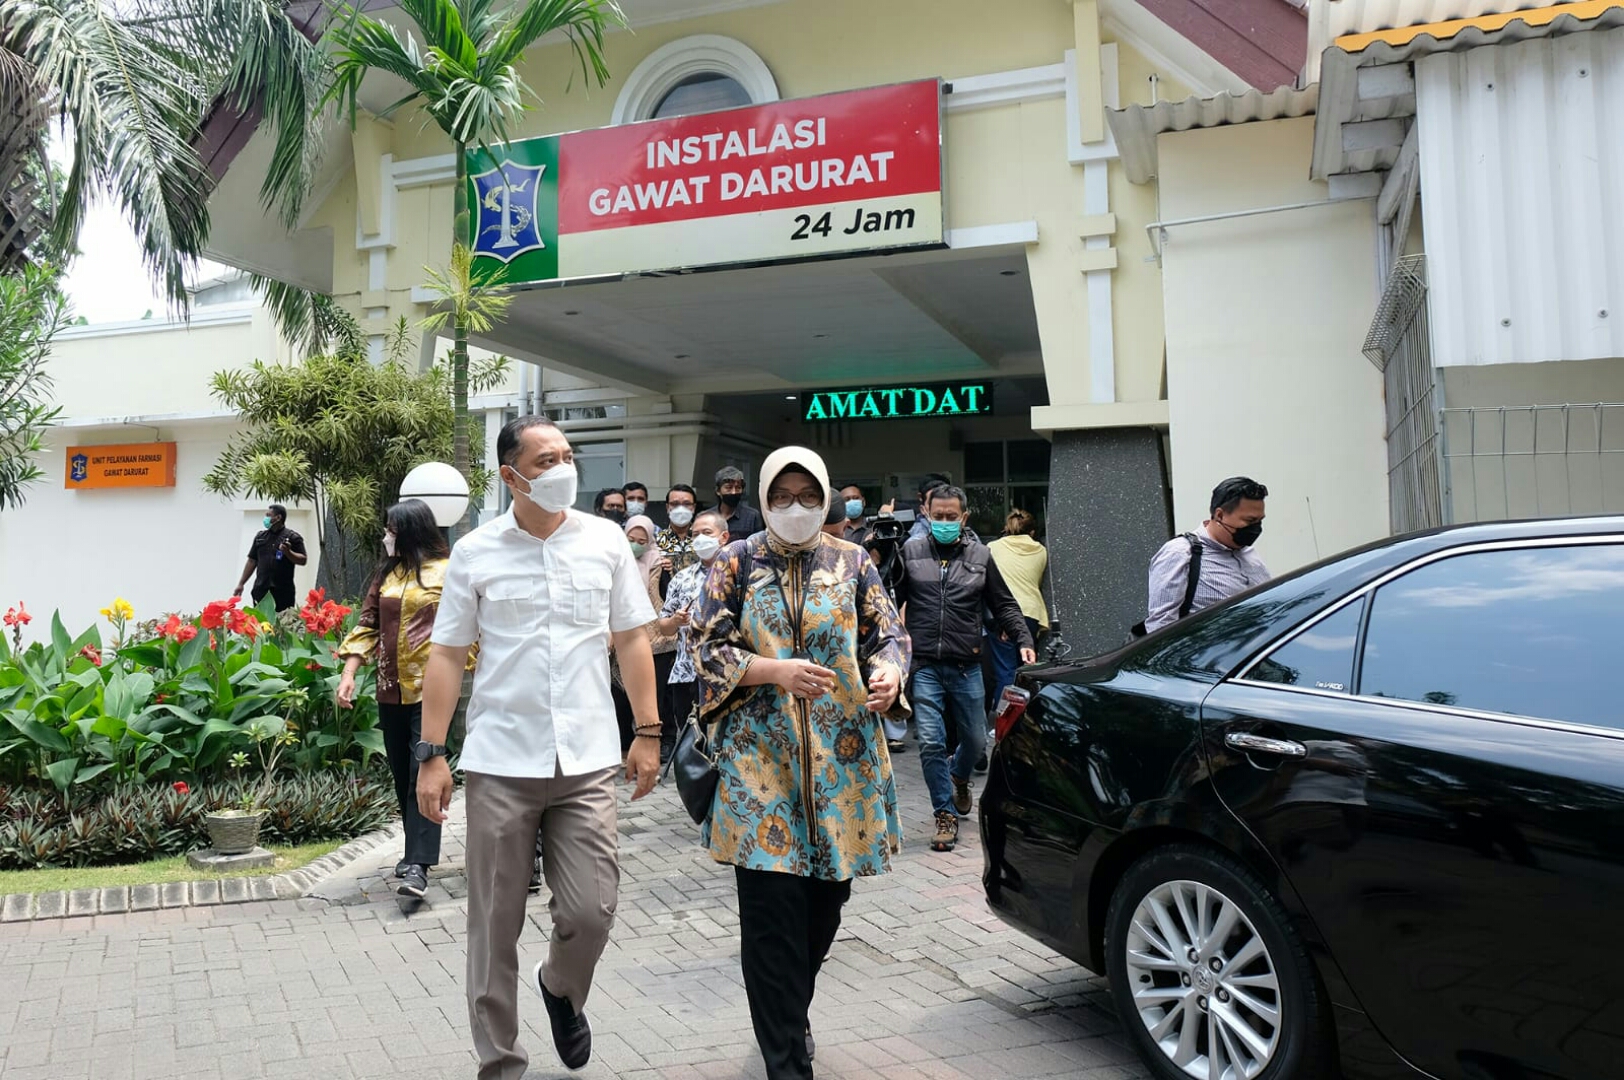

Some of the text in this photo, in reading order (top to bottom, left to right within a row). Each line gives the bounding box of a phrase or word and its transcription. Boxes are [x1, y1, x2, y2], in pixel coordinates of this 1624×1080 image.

[646, 117, 826, 169] INSTALASI
[588, 150, 894, 216] GAWAT DARURAT
[790, 208, 915, 241] 24 Jam
[806, 385, 989, 420] AMAT DAT
[92, 454, 162, 464] UNIT PELAYANAN FARMASI
[104, 467, 149, 477] GAWAT DARURAT
